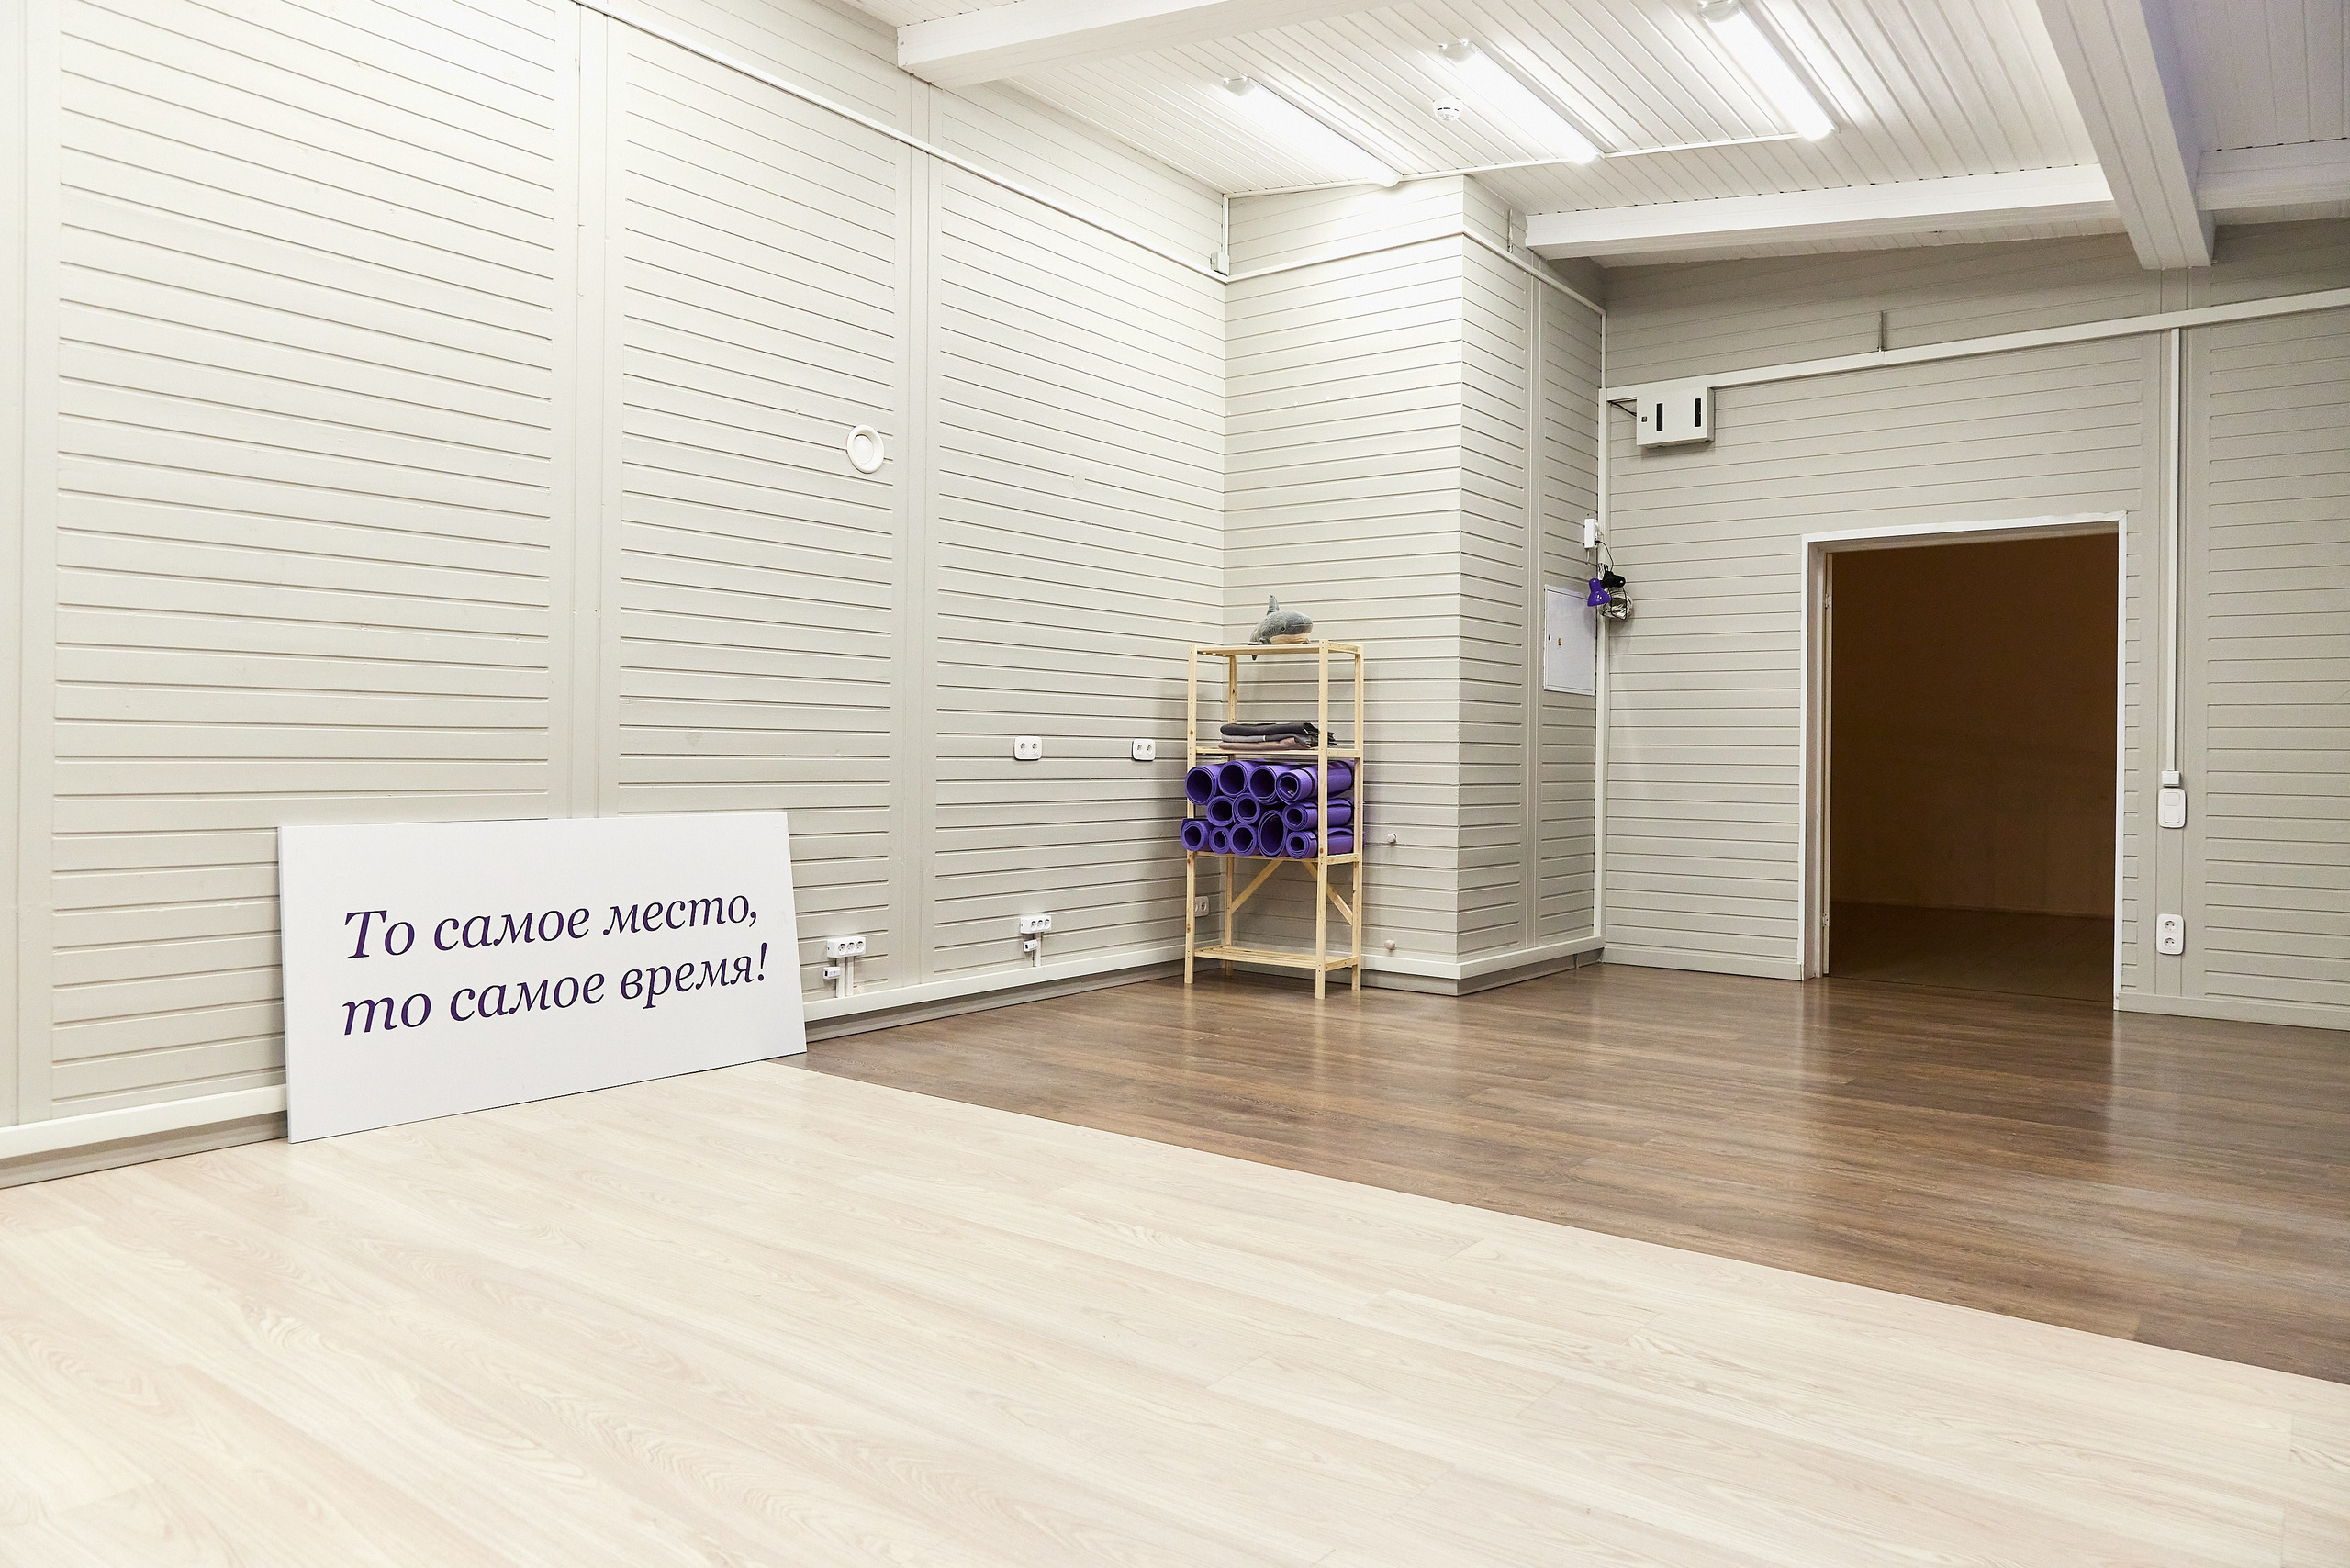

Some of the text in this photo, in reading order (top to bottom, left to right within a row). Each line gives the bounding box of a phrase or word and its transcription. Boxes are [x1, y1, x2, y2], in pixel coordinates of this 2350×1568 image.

[343, 893, 758, 959] То самое место,
[342, 942, 768, 1036] то самое время!
